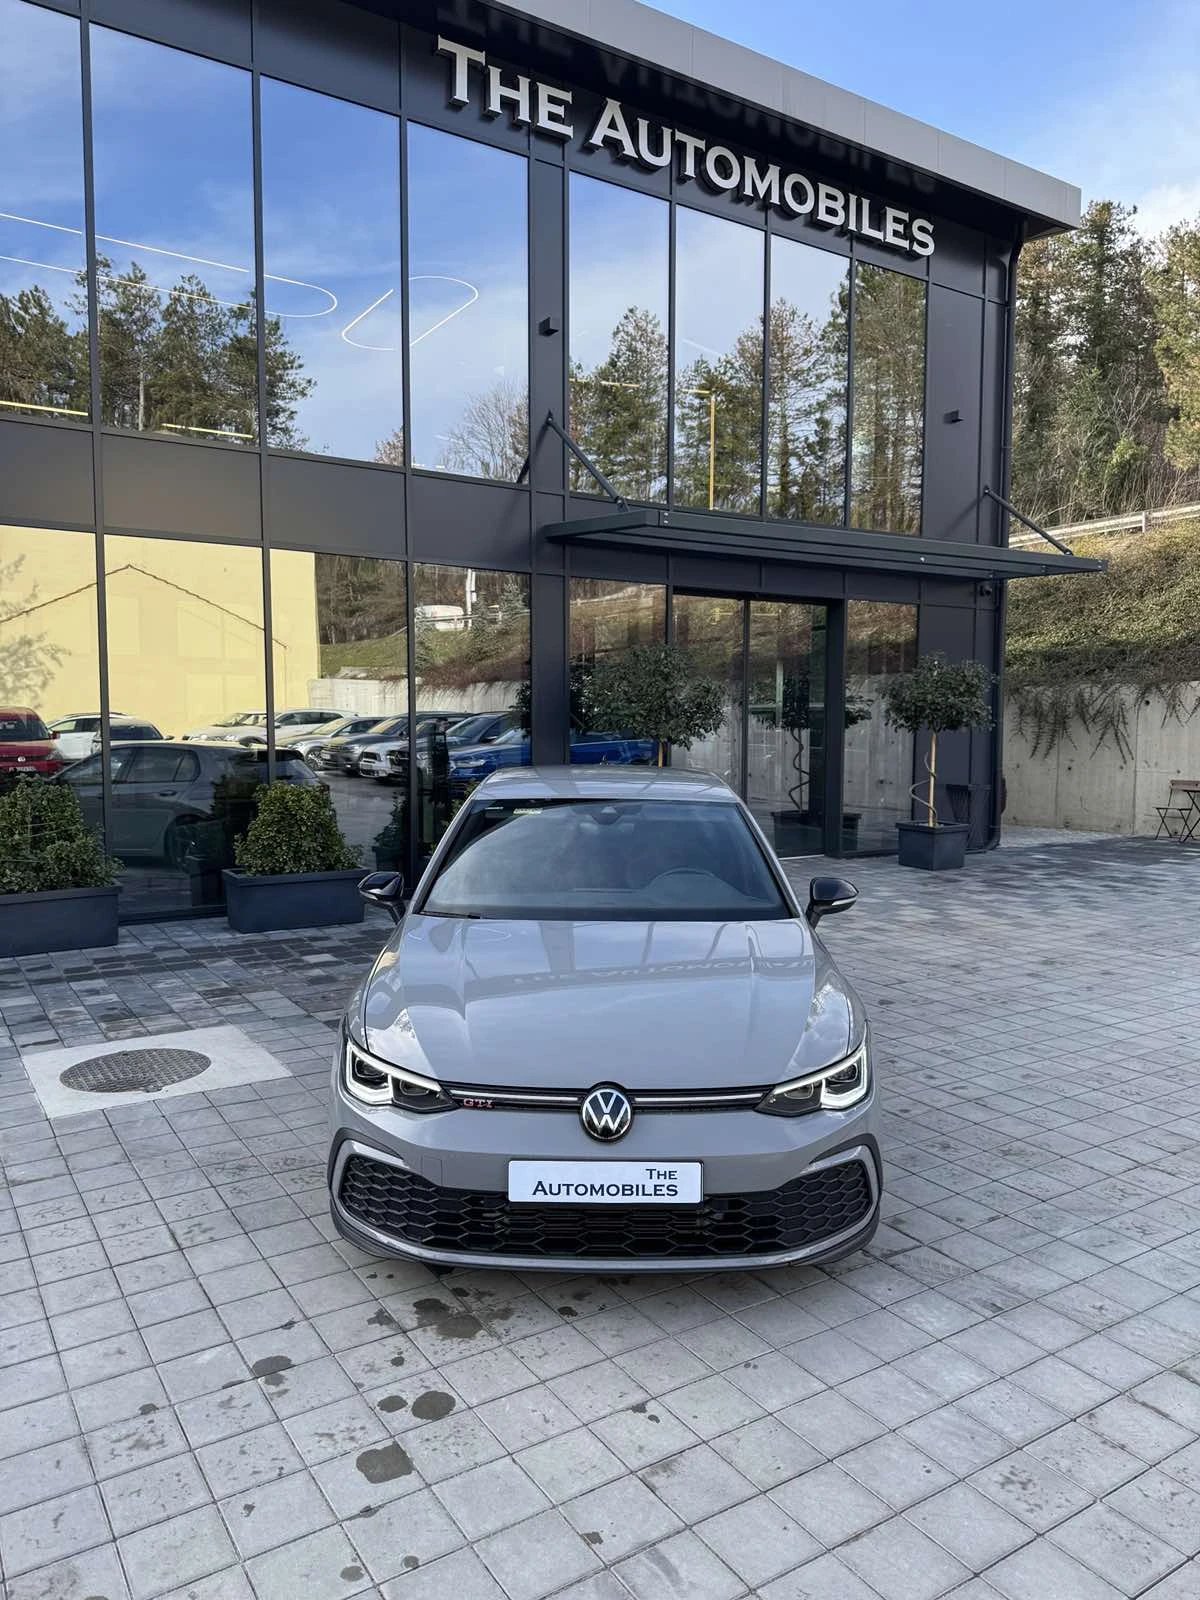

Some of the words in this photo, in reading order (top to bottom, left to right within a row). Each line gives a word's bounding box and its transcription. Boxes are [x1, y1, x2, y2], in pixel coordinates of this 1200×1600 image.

[436, 35, 574, 139] THE
[587, 98, 935, 257] AUTOMOBILES
[463, 1098, 495, 1108] GTI
[645, 1168, 678, 1180] THE
[532, 1181, 679, 1197] AUTOMOBILES
